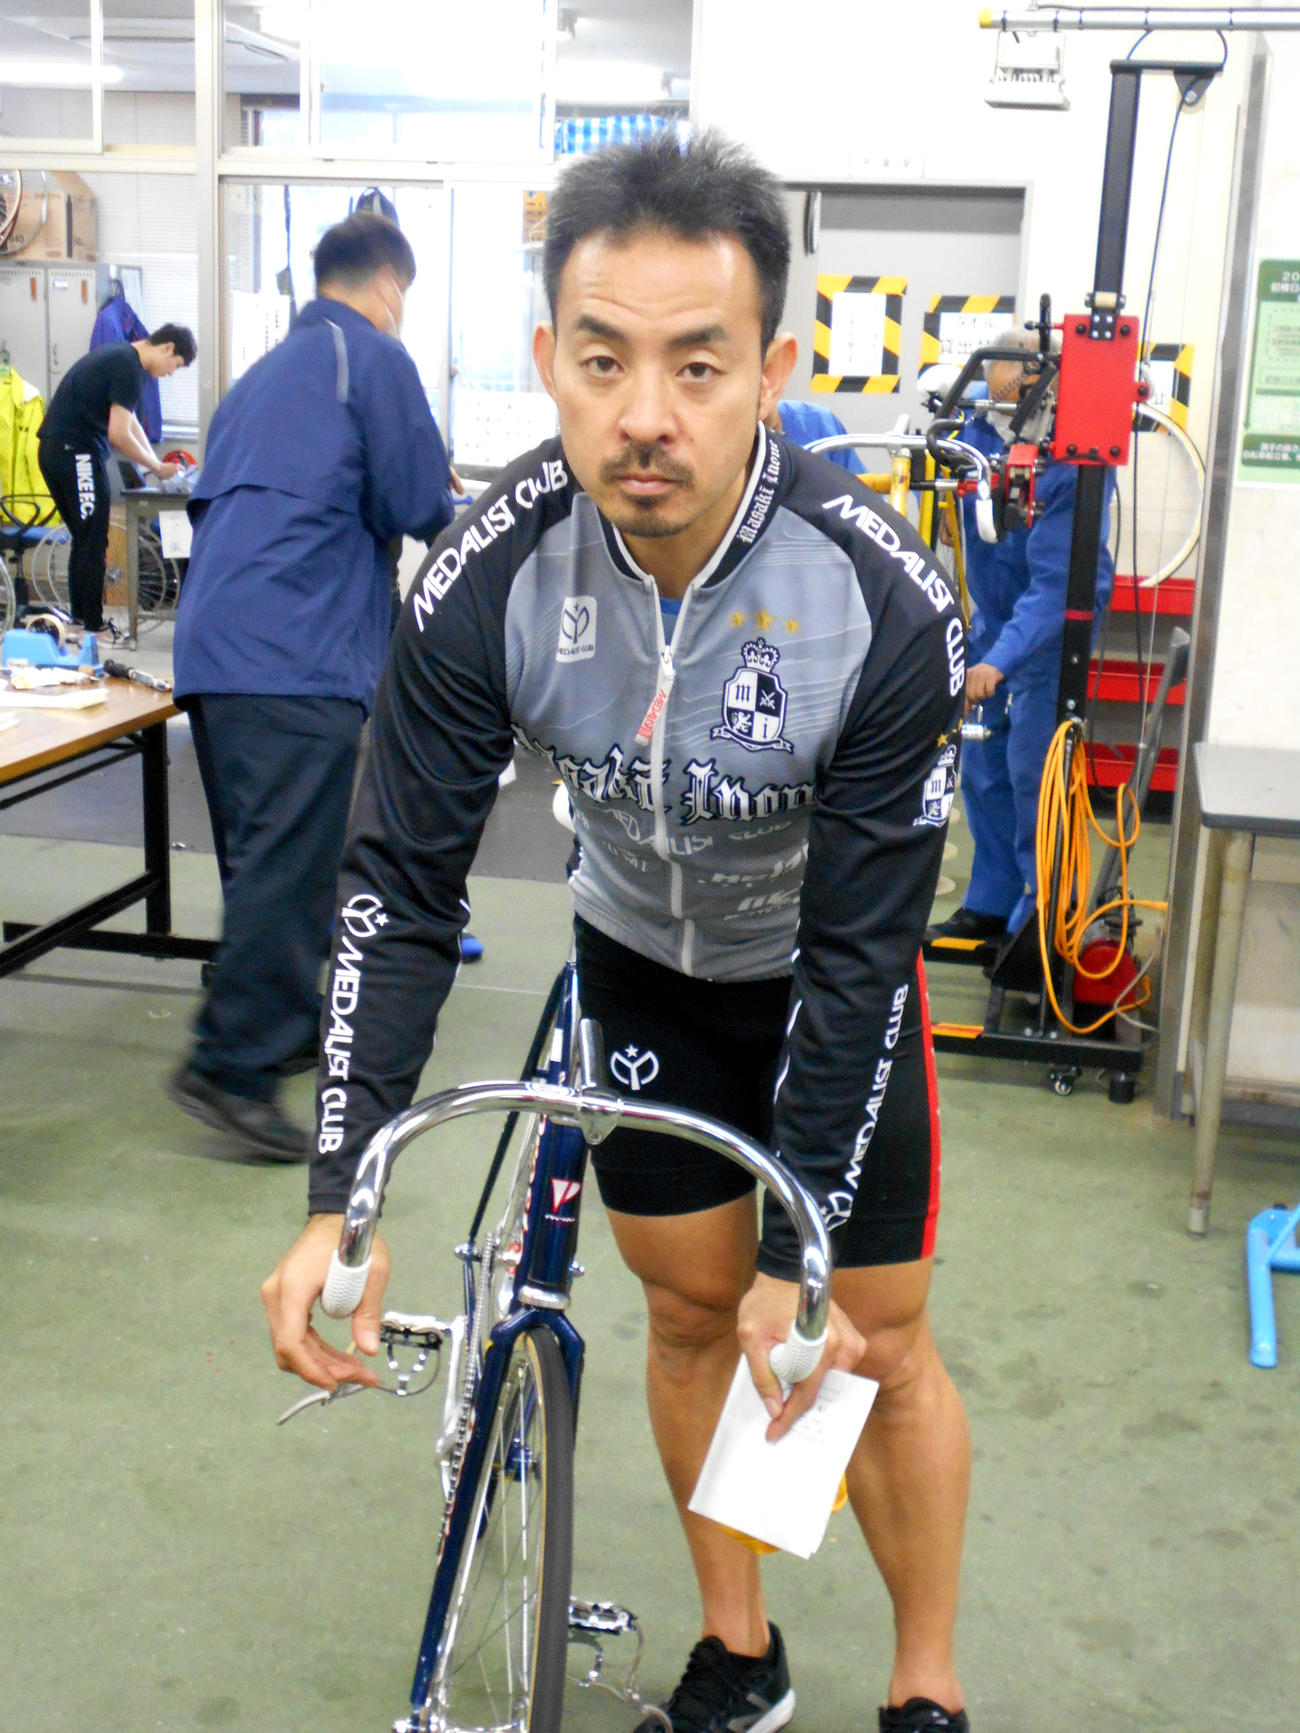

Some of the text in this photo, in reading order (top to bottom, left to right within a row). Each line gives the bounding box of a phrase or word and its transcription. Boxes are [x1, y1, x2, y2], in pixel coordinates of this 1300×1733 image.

[75, 453, 95, 491] NIKE
[736, 484, 775, 544] Masaki
[413, 495, 516, 632] MEDALIST
[822, 494, 967, 697] MEDALIST CLUB
[681, 757, 817, 826] Inou
[318, 936, 364, 1154] MEDALIST CLUB
[845, 983, 909, 1190] MEDALIST CLUB
